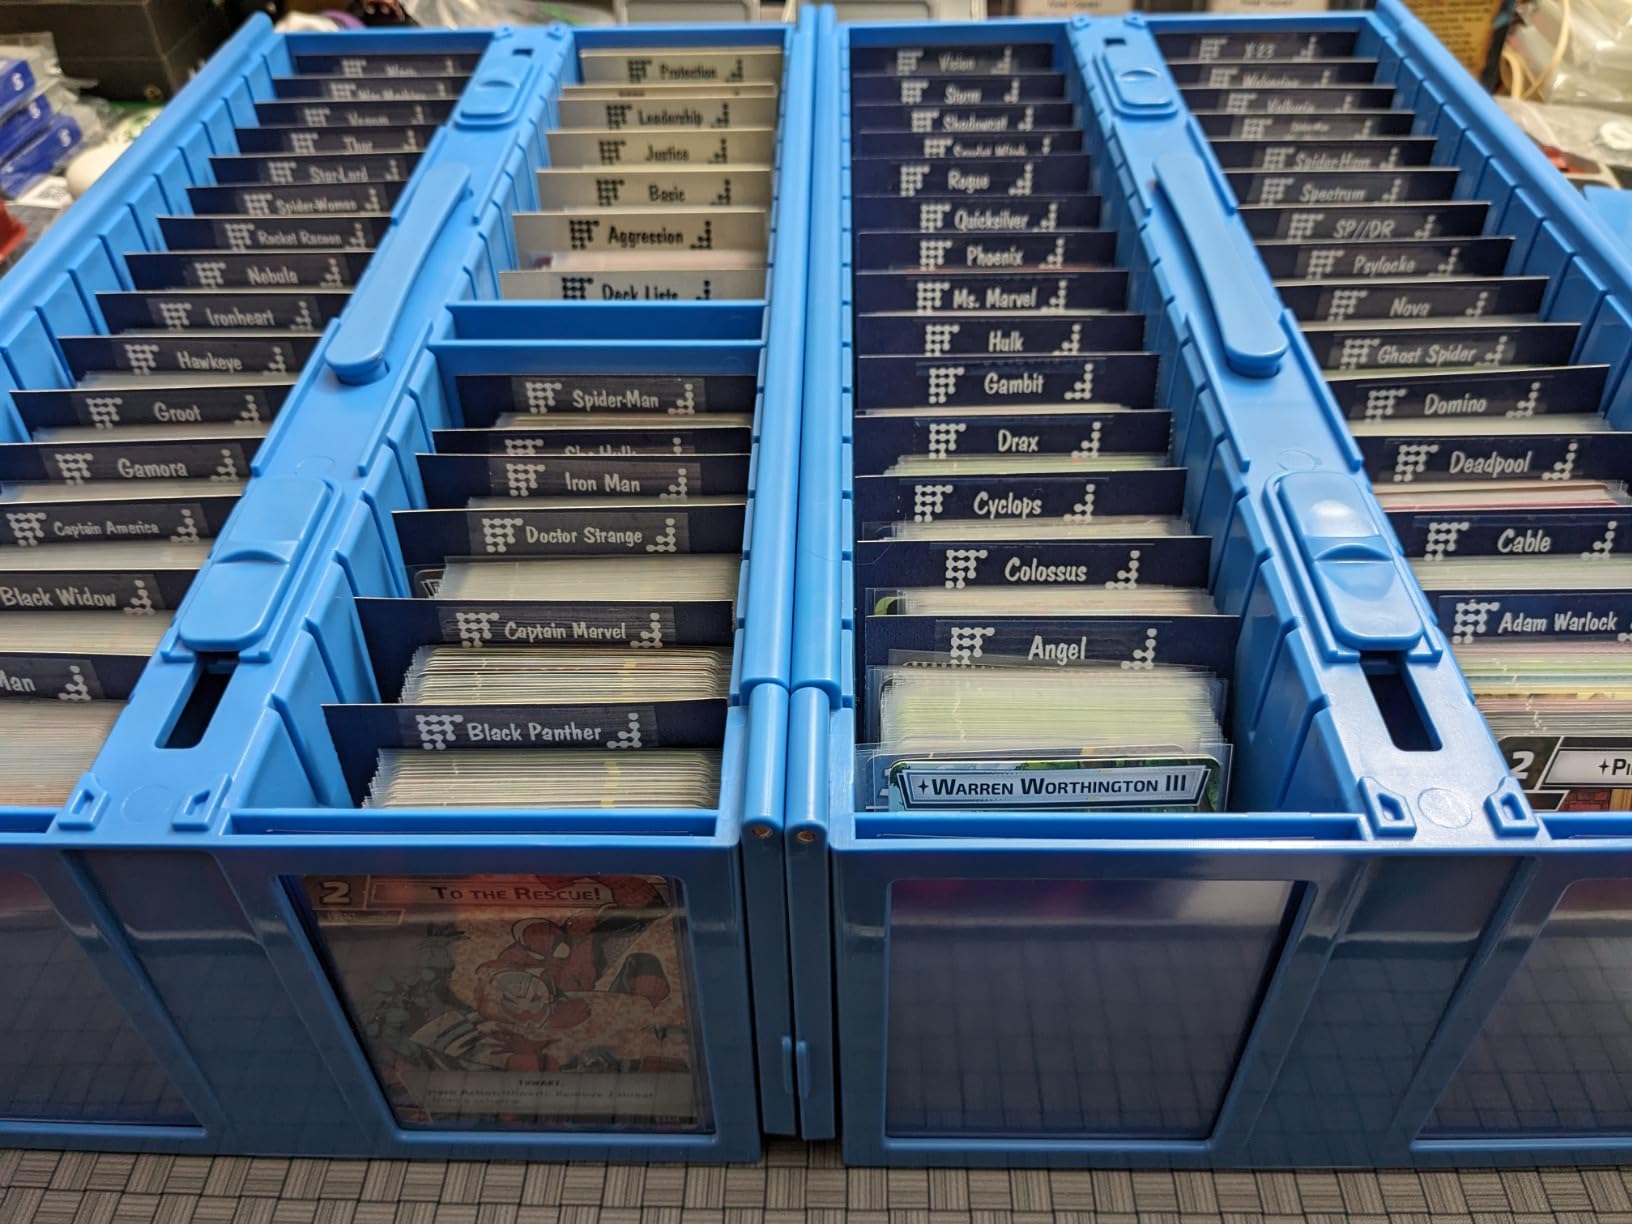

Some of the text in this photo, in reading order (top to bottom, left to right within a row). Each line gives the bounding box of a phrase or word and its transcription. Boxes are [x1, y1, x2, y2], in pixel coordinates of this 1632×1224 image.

[659, 62, 718, 79] Protection
[638, 108, 704, 128] Leadership
[342, 135, 373, 154] Thor
[645, 145, 689, 162] Justice
[948, 167, 990, 194] Rogue
[648, 184, 687, 203] Basic
[1300, 182, 1366, 205] Spectrum
[954, 208, 1029, 233] Quicksilver
[257, 230, 297, 246] Rocket
[607, 226, 684, 248] Aggression
[966, 245, 1024, 267] Phoenix
[1352, 255, 1417, 278] Psylocke
[246, 265, 299, 285] Nebula
[602, 284, 639, 300] Deck
[953, 287, 1038, 309] Ms. Marvel
[205, 308, 276, 326] Ironheart
[1389, 296, 1432, 317] Nova
[988, 330, 1024, 353] Hulk
[176, 351, 243, 374] Hawkeye
[1377, 344, 1478, 367] Ghost Spider
[984, 372, 1045, 395] Gambit
[572, 389, 660, 412] Spider-Man
[1423, 393, 1488, 415] Domino
[153, 402, 202, 423] Groot
[998, 429, 1040, 453] Drax
[117, 458, 189, 479] Gamora
[1449, 450, 1533, 478] Deadpool
[565, 471, 641, 493] Iron Man
[973, 491, 1043, 520] Cyclops
[53, 521, 160, 538] Captain America
[525, 526, 643, 547] Doctor Strange
[1497, 528, 1552, 553] Cable
[1004, 557, 1088, 582] Colossus
[0, 587, 118, 608] Black Widow
[504, 621, 627, 643] Captain Marvel
[1497, 611, 1619, 634] Adam Warlock
[1028, 635, 1087, 665] Angel
[467, 721, 602, 742] Black Panther
[1510, 751, 1535, 780] 2
[932, 774, 1187, 796] WARREN WORTHINGTON III
[320, 880, 351, 906] 2
[431, 886, 600, 901] TO THE RESCUE!
